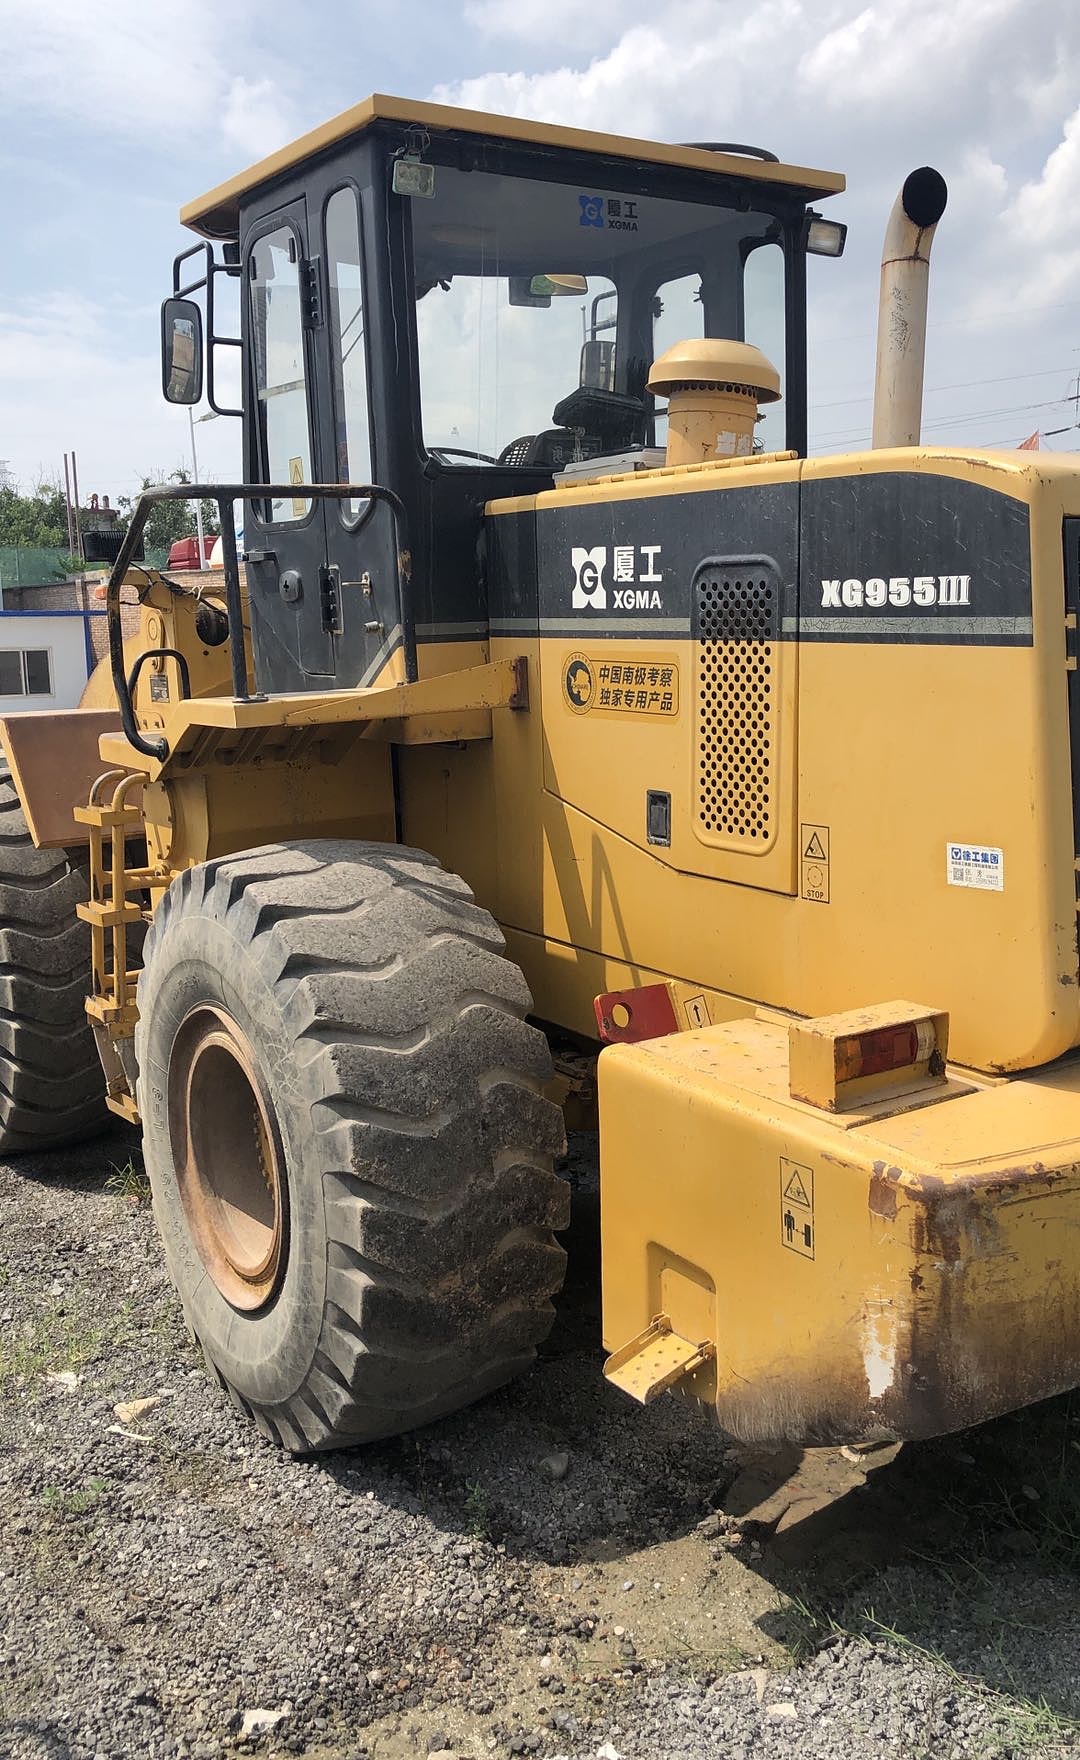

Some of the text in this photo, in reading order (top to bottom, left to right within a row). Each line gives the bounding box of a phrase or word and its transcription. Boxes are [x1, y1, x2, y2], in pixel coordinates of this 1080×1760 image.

[608, 220, 638, 232] XGMA
[613, 545, 663, 582] 厦工
[613, 590, 662, 609] XGMA
[599, 665, 673, 688] 中国南极考察
[599, 687, 673, 711] 独家专用产品
[806, 889, 824, 899] STOP
